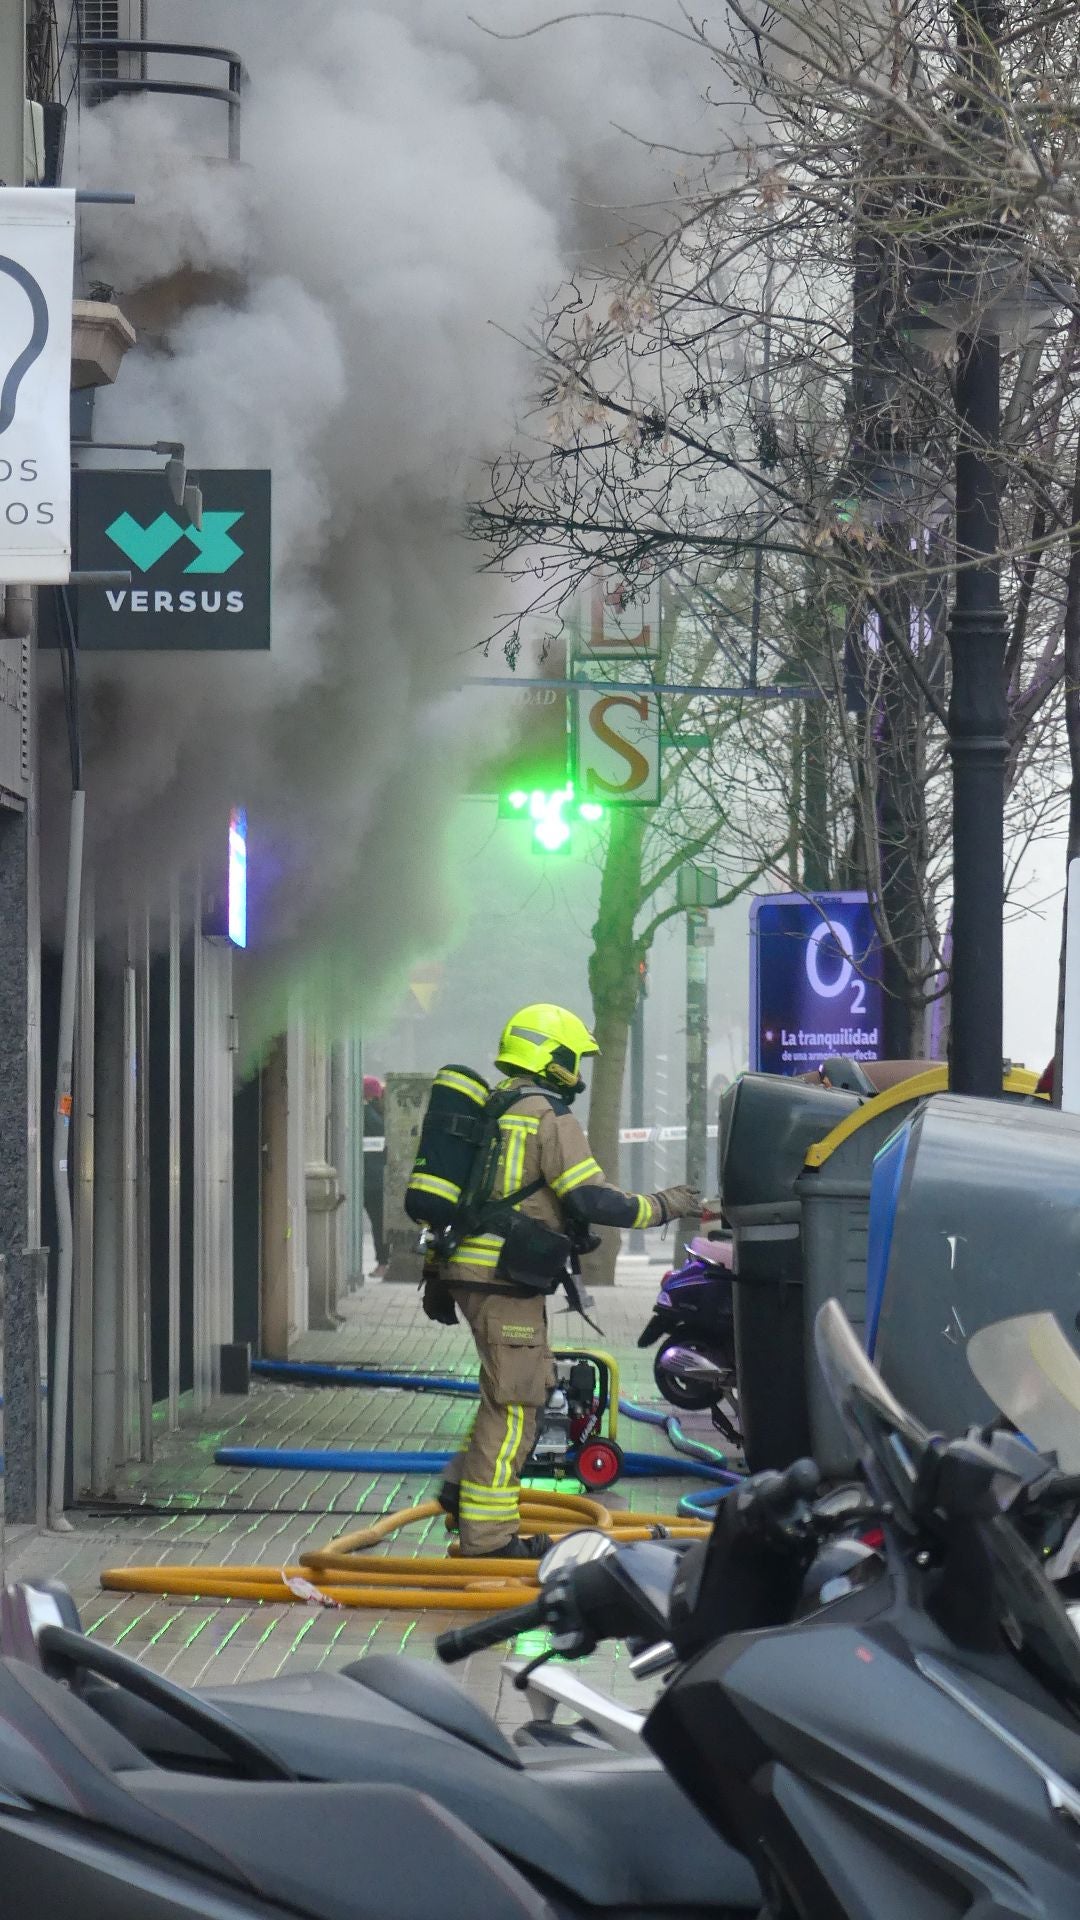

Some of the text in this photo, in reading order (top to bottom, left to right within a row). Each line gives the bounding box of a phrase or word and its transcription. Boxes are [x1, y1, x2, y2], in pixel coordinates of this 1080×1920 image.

[105, 590, 244, 613] VERSUS
[781, 1027, 878, 1050] La tranquilidad
[781, 1050, 793, 1061] de
